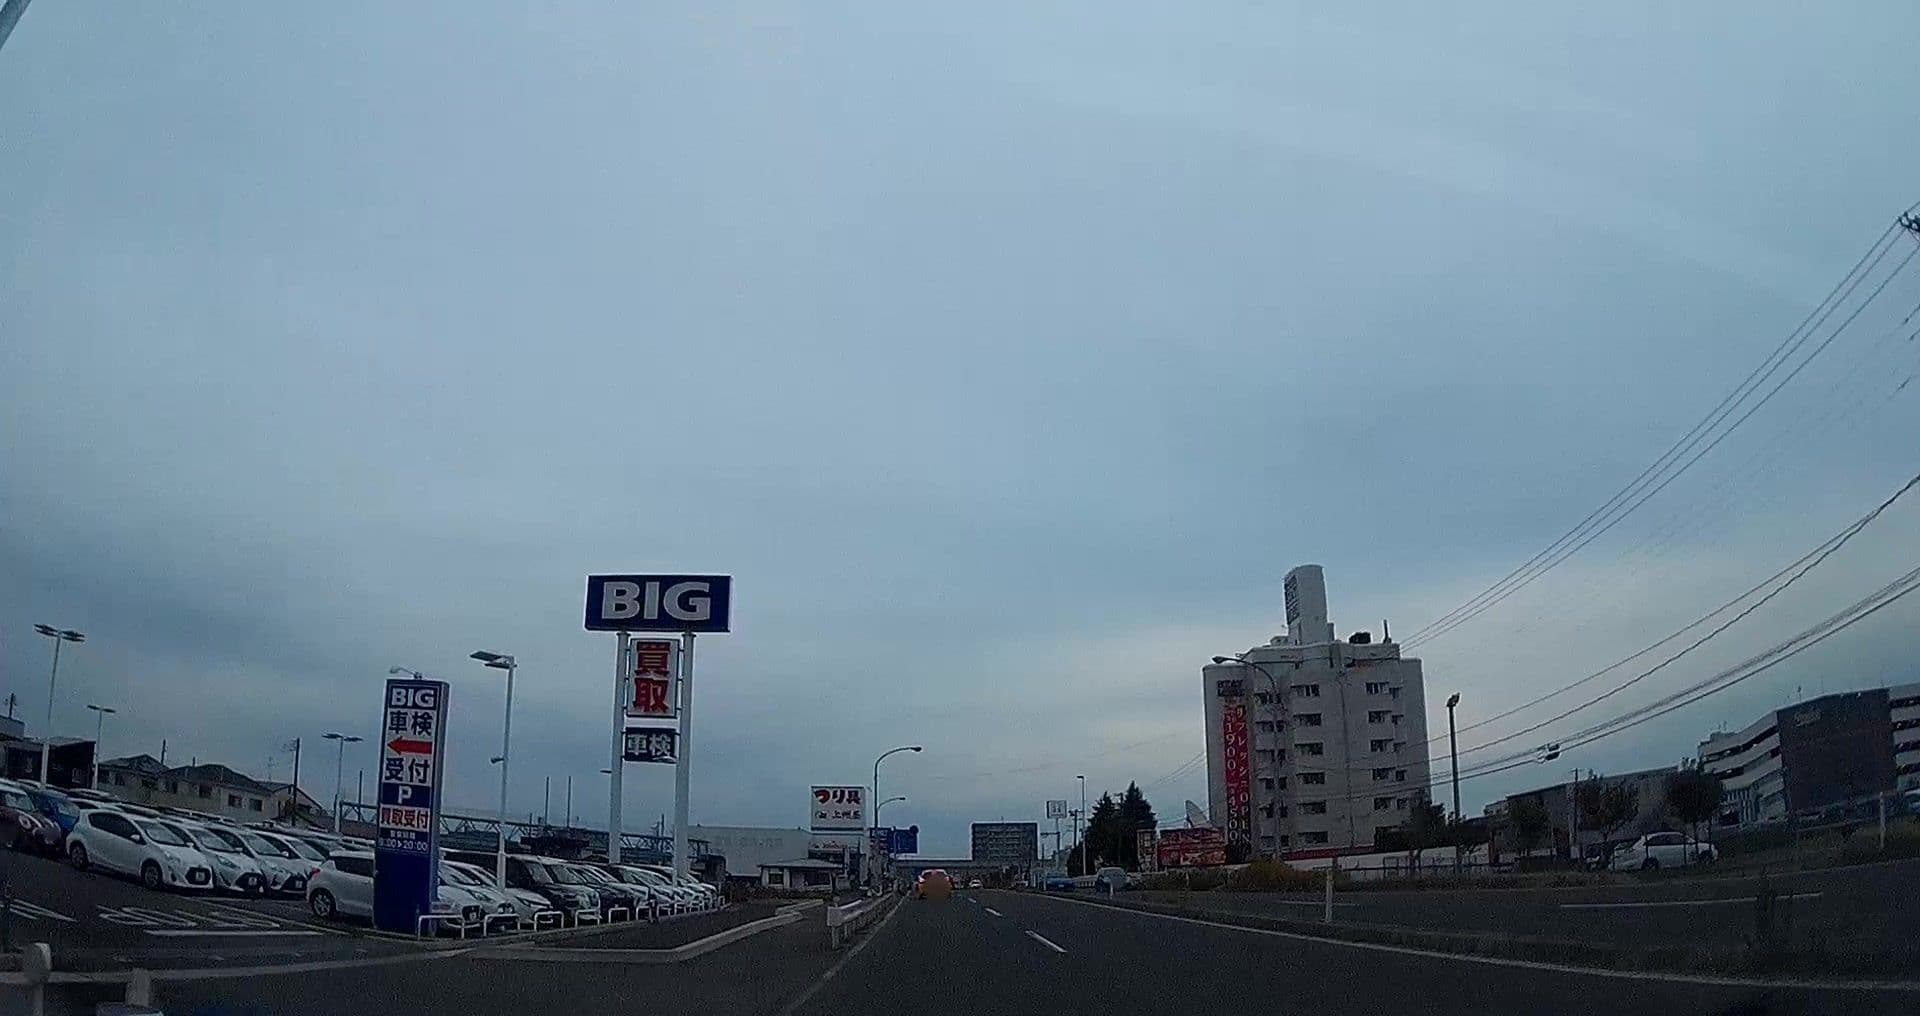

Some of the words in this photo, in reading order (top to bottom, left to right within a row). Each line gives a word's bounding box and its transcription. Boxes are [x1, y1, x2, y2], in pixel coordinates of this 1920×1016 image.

[601, 582, 711, 621] BIG
[633, 641, 671, 713] 買取
[391, 687, 435, 708] BIG
[388, 710, 433, 737] 車検
[627, 733, 673, 757] 車検
[384, 757, 431, 784] 受付
[397, 785, 412, 804] P
[814, 789, 861, 805] つり具
[381, 807, 430, 830] 買取受付
